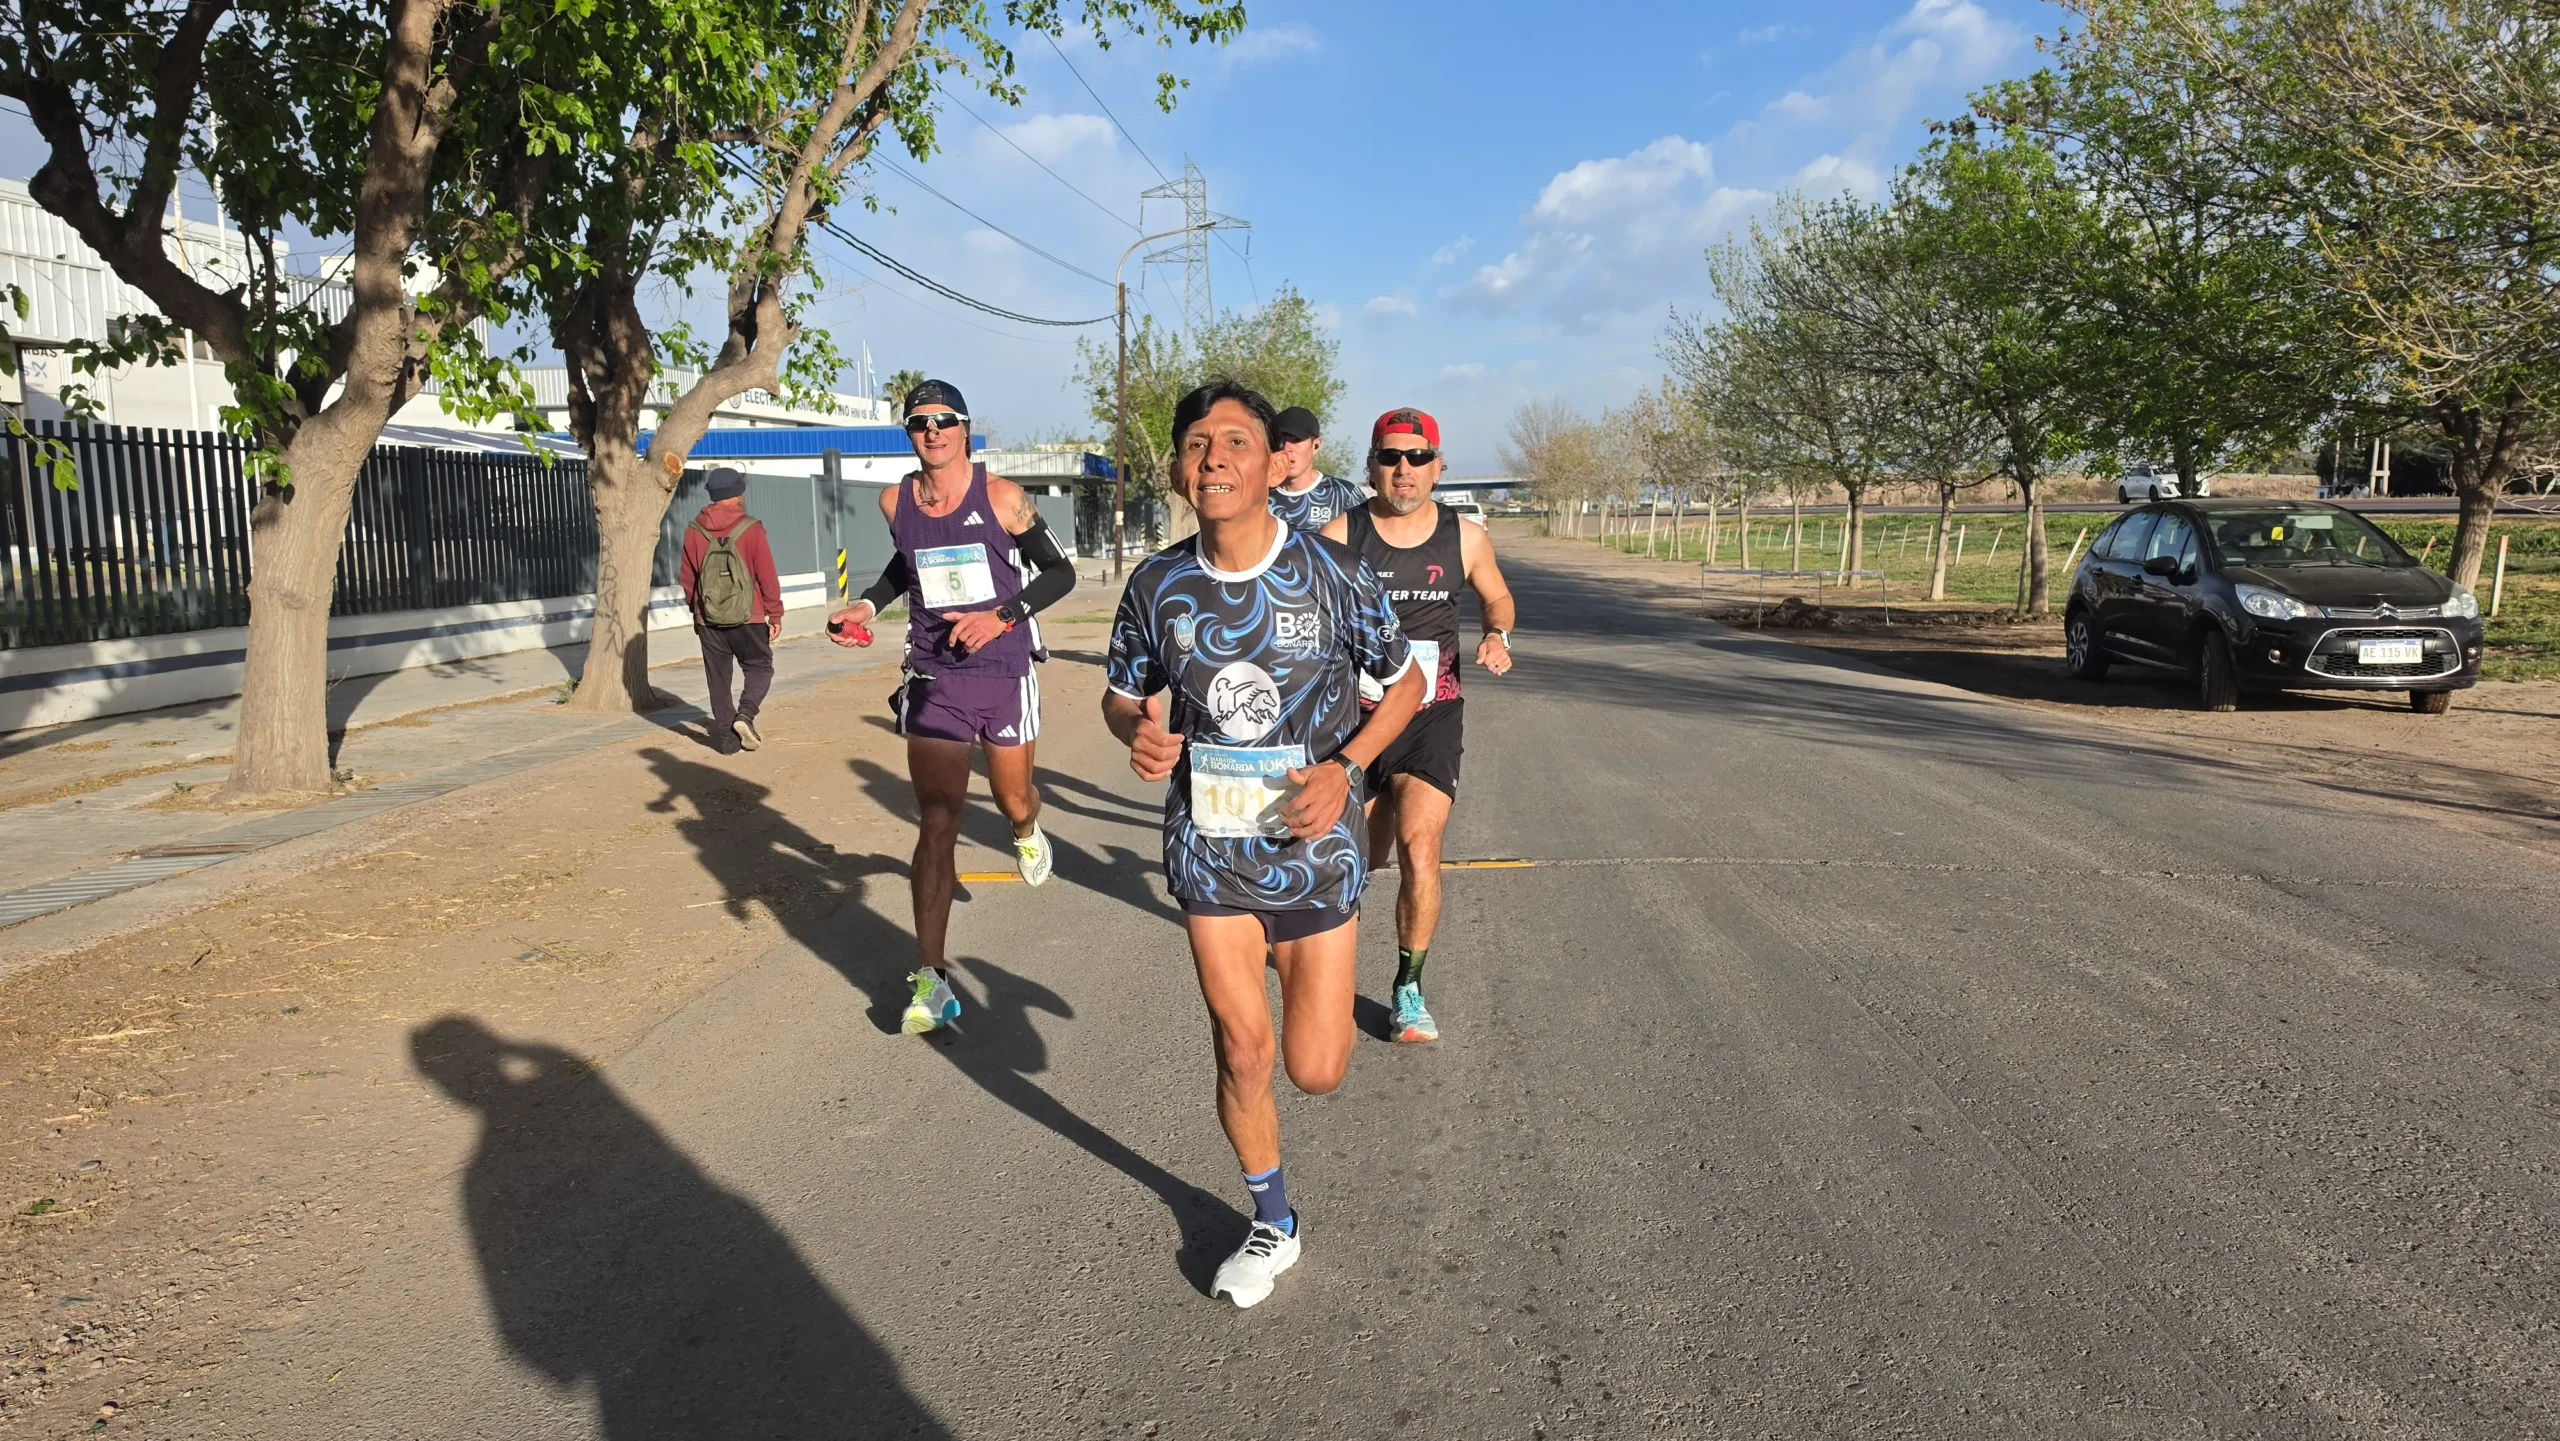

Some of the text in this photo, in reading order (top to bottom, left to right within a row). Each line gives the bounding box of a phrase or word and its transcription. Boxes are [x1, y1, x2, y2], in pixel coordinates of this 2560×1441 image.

[949, 571, 961, 591] 5
[1411, 590, 1450, 601] TEAM
[2363, 647, 2418, 658] AE 115 VK
[1210, 758, 1289, 774] BONARDA 10K
